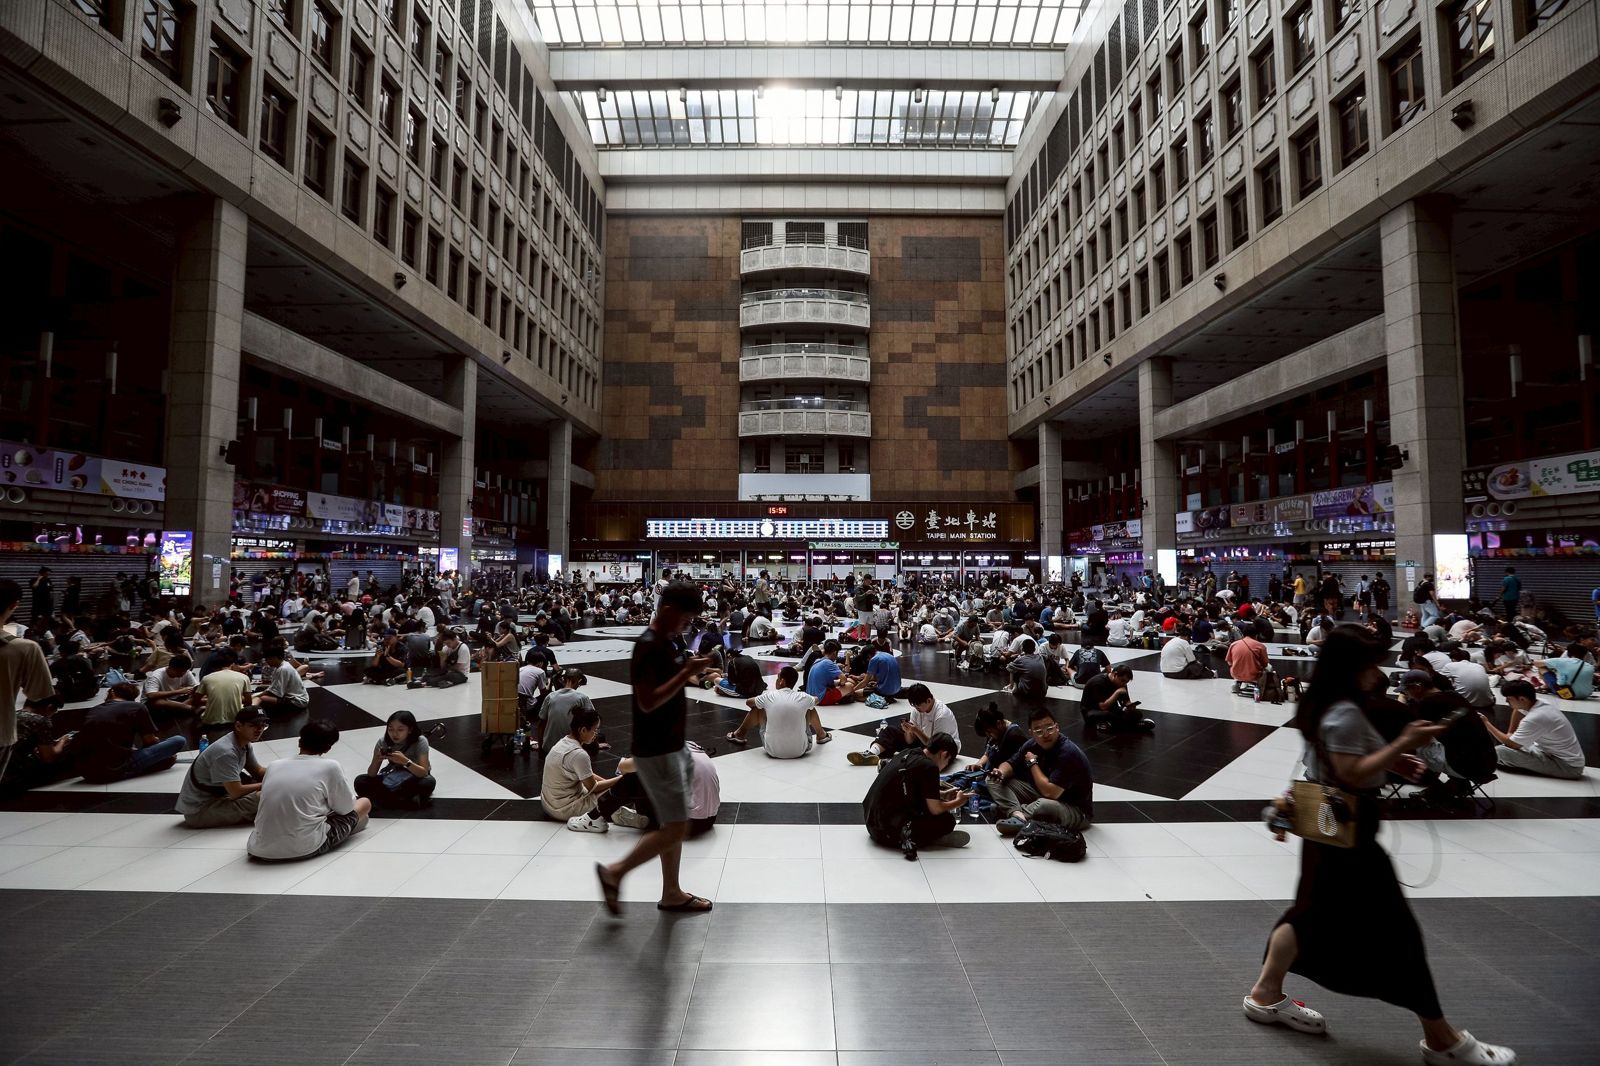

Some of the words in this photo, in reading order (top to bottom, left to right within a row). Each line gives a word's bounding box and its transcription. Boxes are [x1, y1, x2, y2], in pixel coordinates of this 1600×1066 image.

[272, 490, 299, 499] SHOPPING
[924, 509, 997, 531] 臺北車站
[970, 532, 997, 540] STATION
